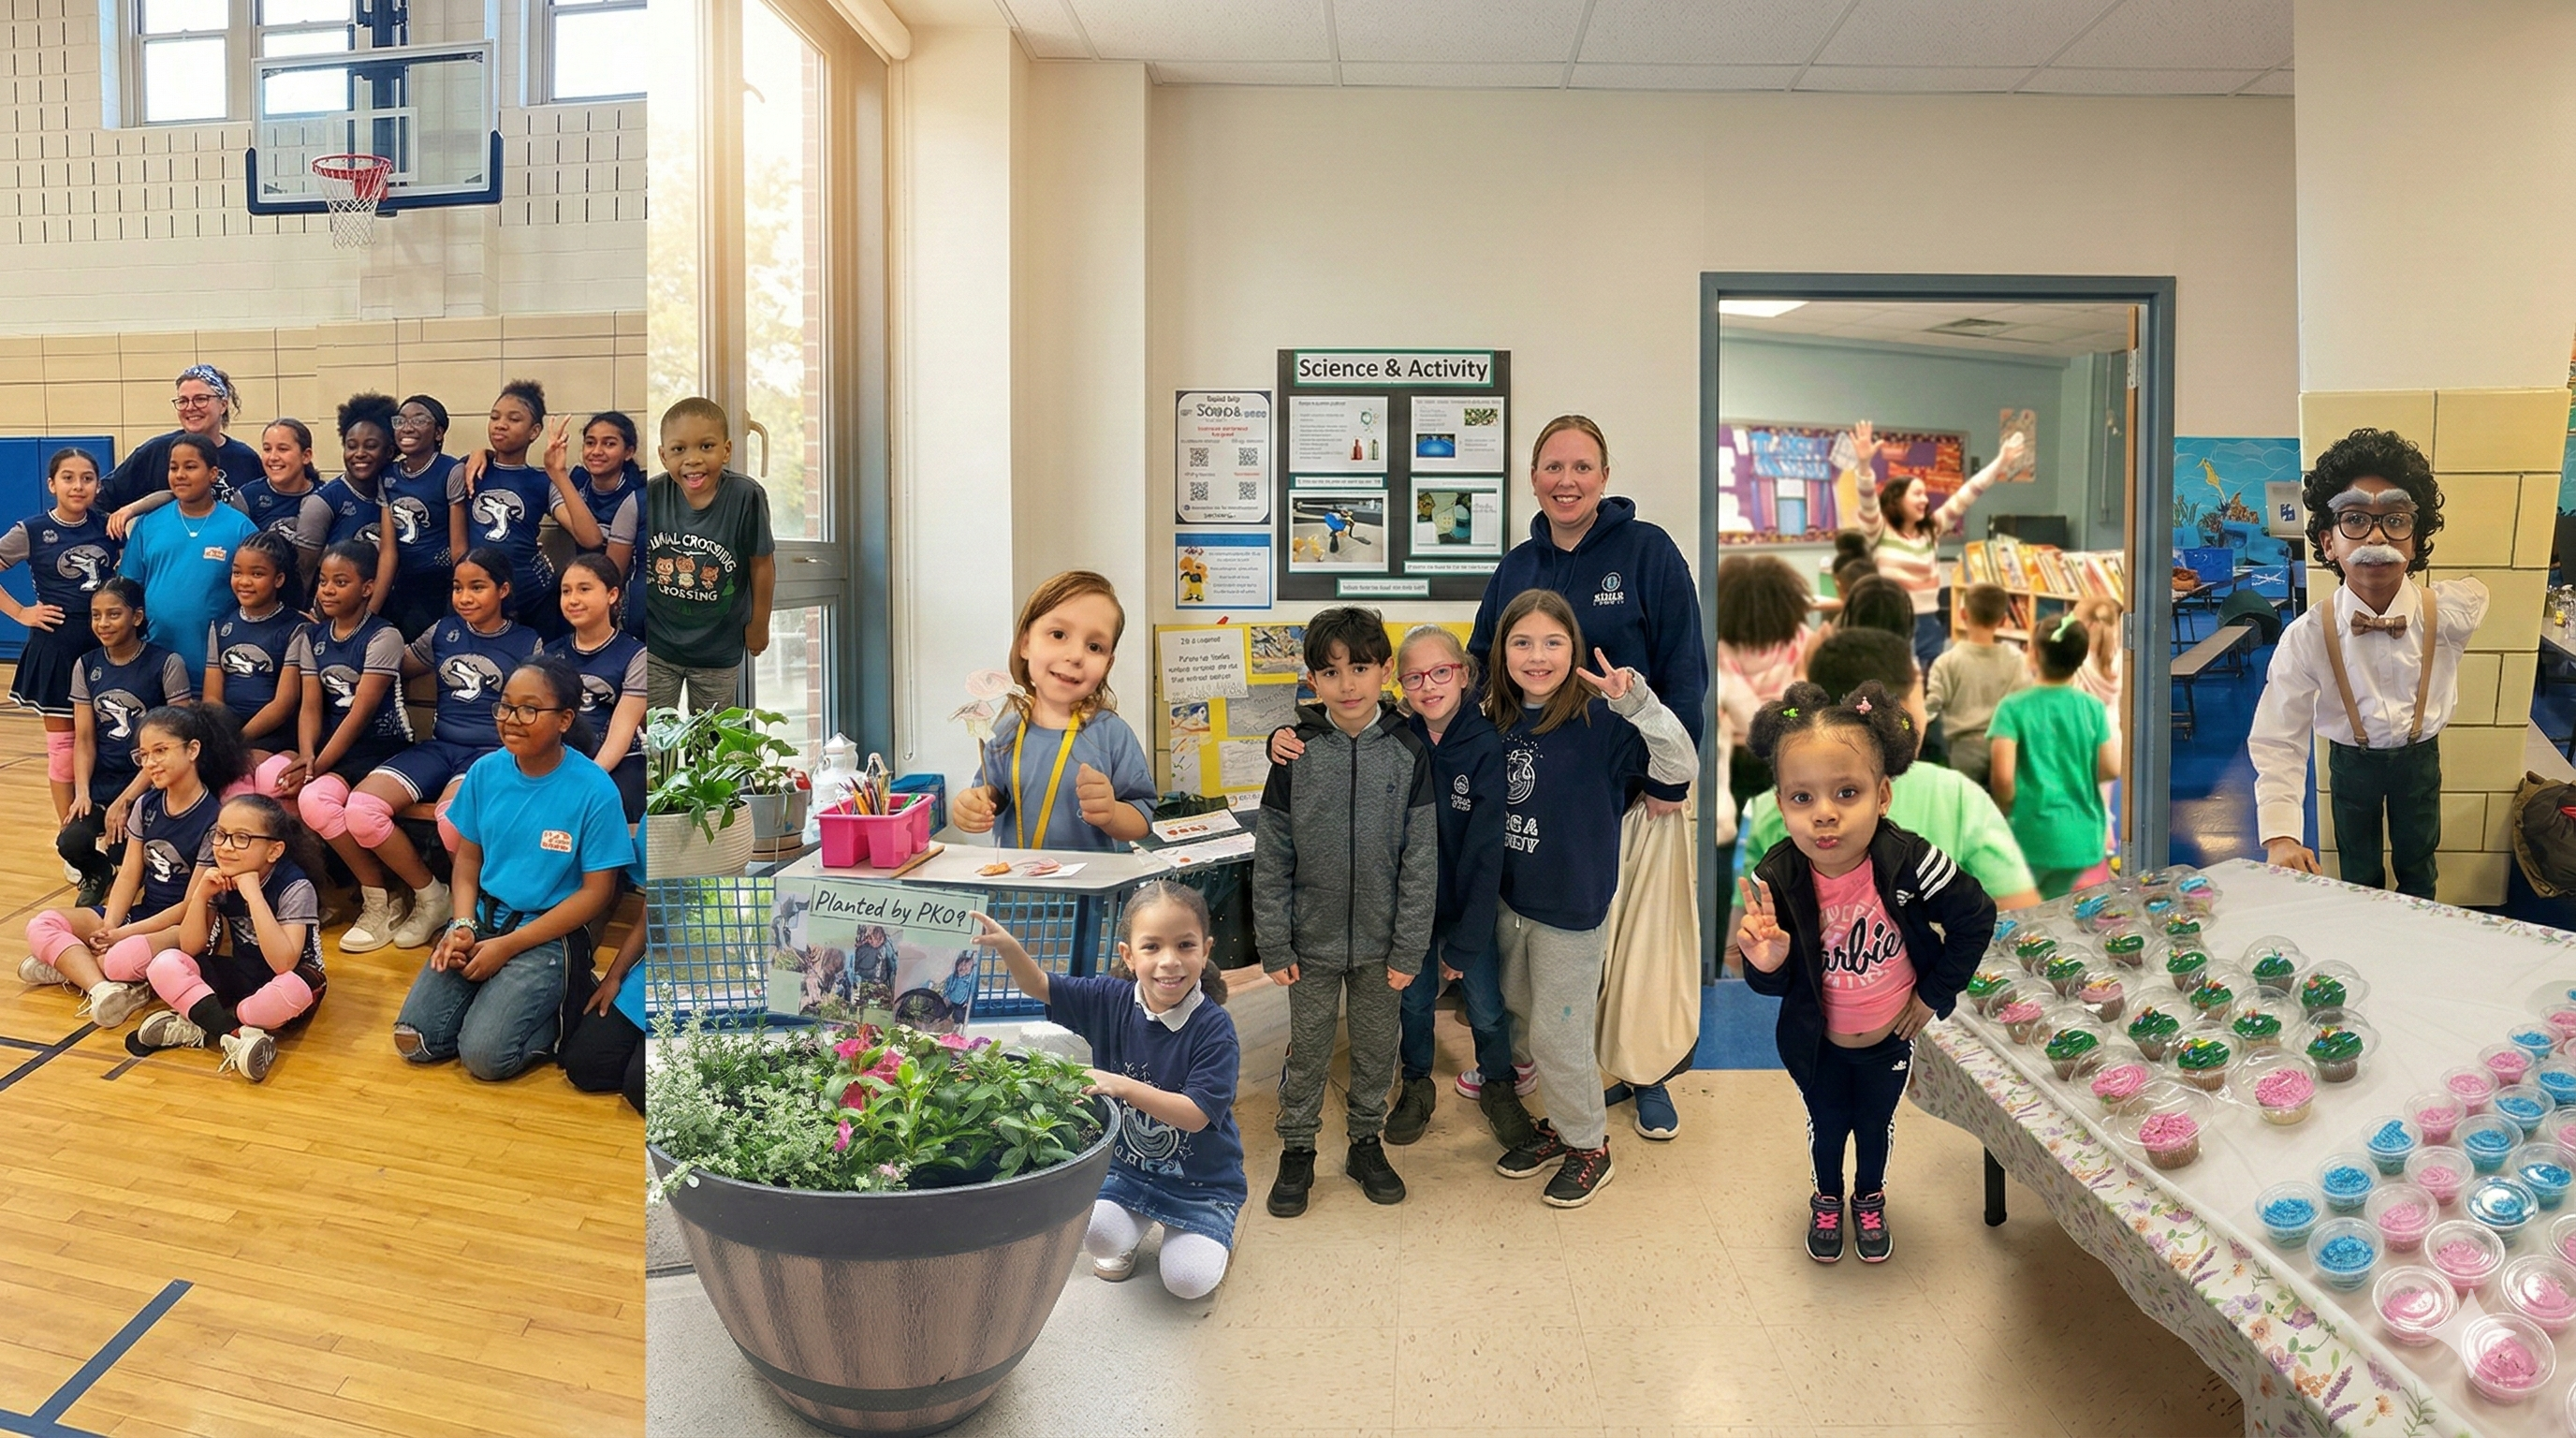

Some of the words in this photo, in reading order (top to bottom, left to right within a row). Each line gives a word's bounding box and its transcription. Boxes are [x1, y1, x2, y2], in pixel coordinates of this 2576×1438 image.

[1298, 358, 1379, 378] Science
[1384, 358, 1402, 378] &
[1408, 358, 1488, 382] Activity
[814, 889, 888, 918] Planted
[891, 898, 913, 925] by
[1821, 917, 1905, 976] arbie
